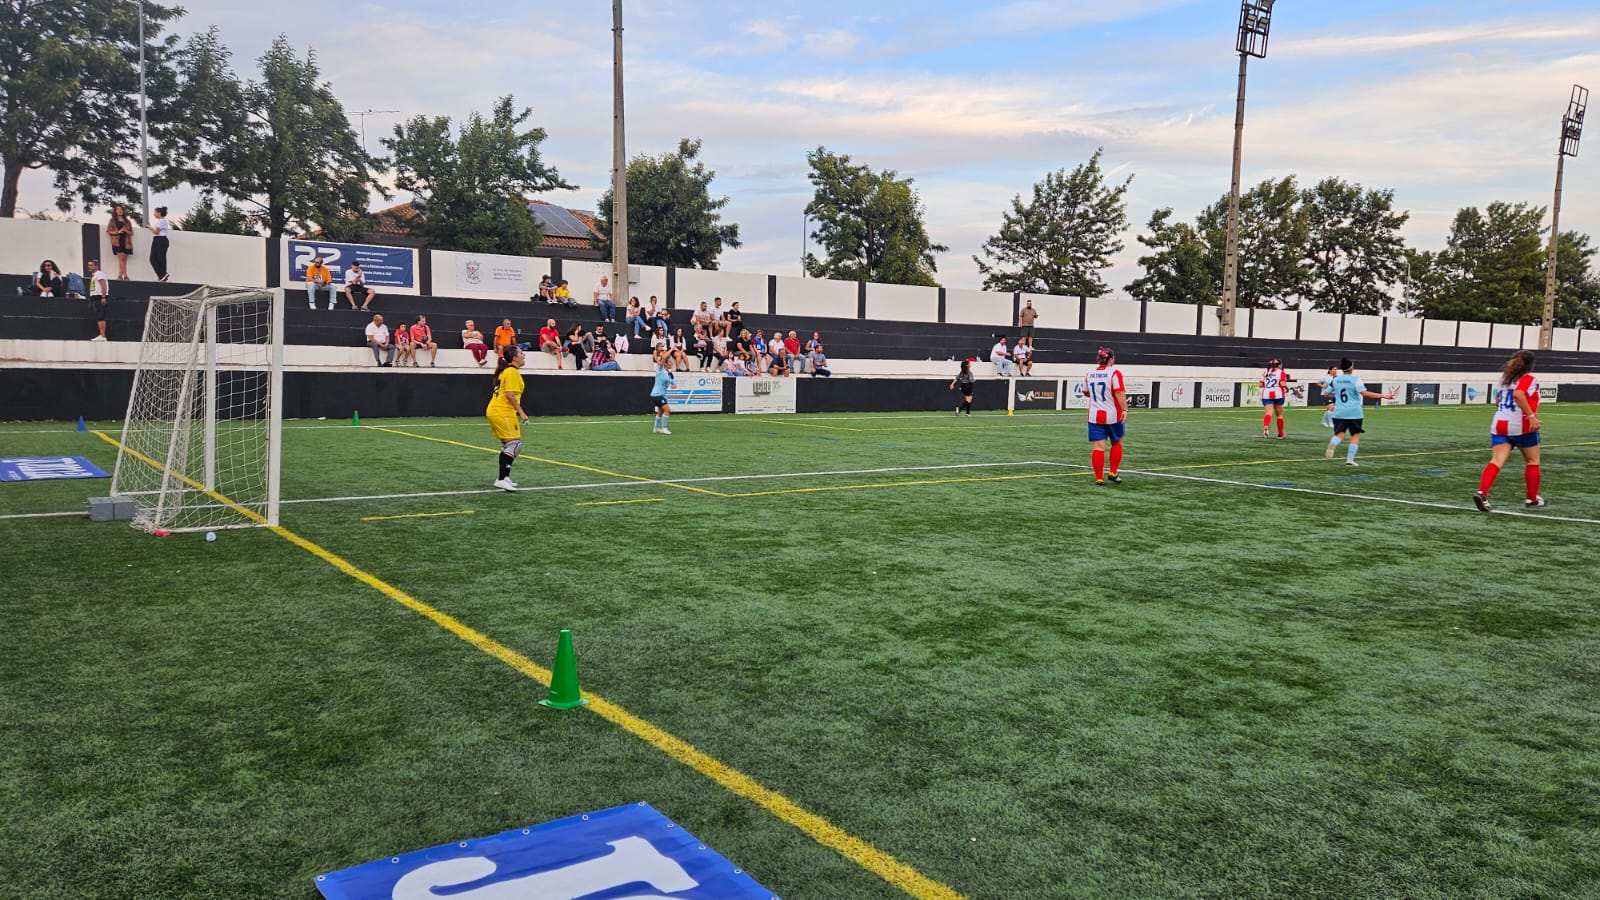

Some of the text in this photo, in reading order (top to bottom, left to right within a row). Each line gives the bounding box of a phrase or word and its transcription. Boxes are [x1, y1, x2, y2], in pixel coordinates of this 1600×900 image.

[1265, 378, 1278, 389] 22
[1089, 381, 1106, 402] 17
[1205, 394, 1230, 402] PACHECO
[1340, 388, 1348, 403] 6
[1496, 388, 1516, 412] 14
